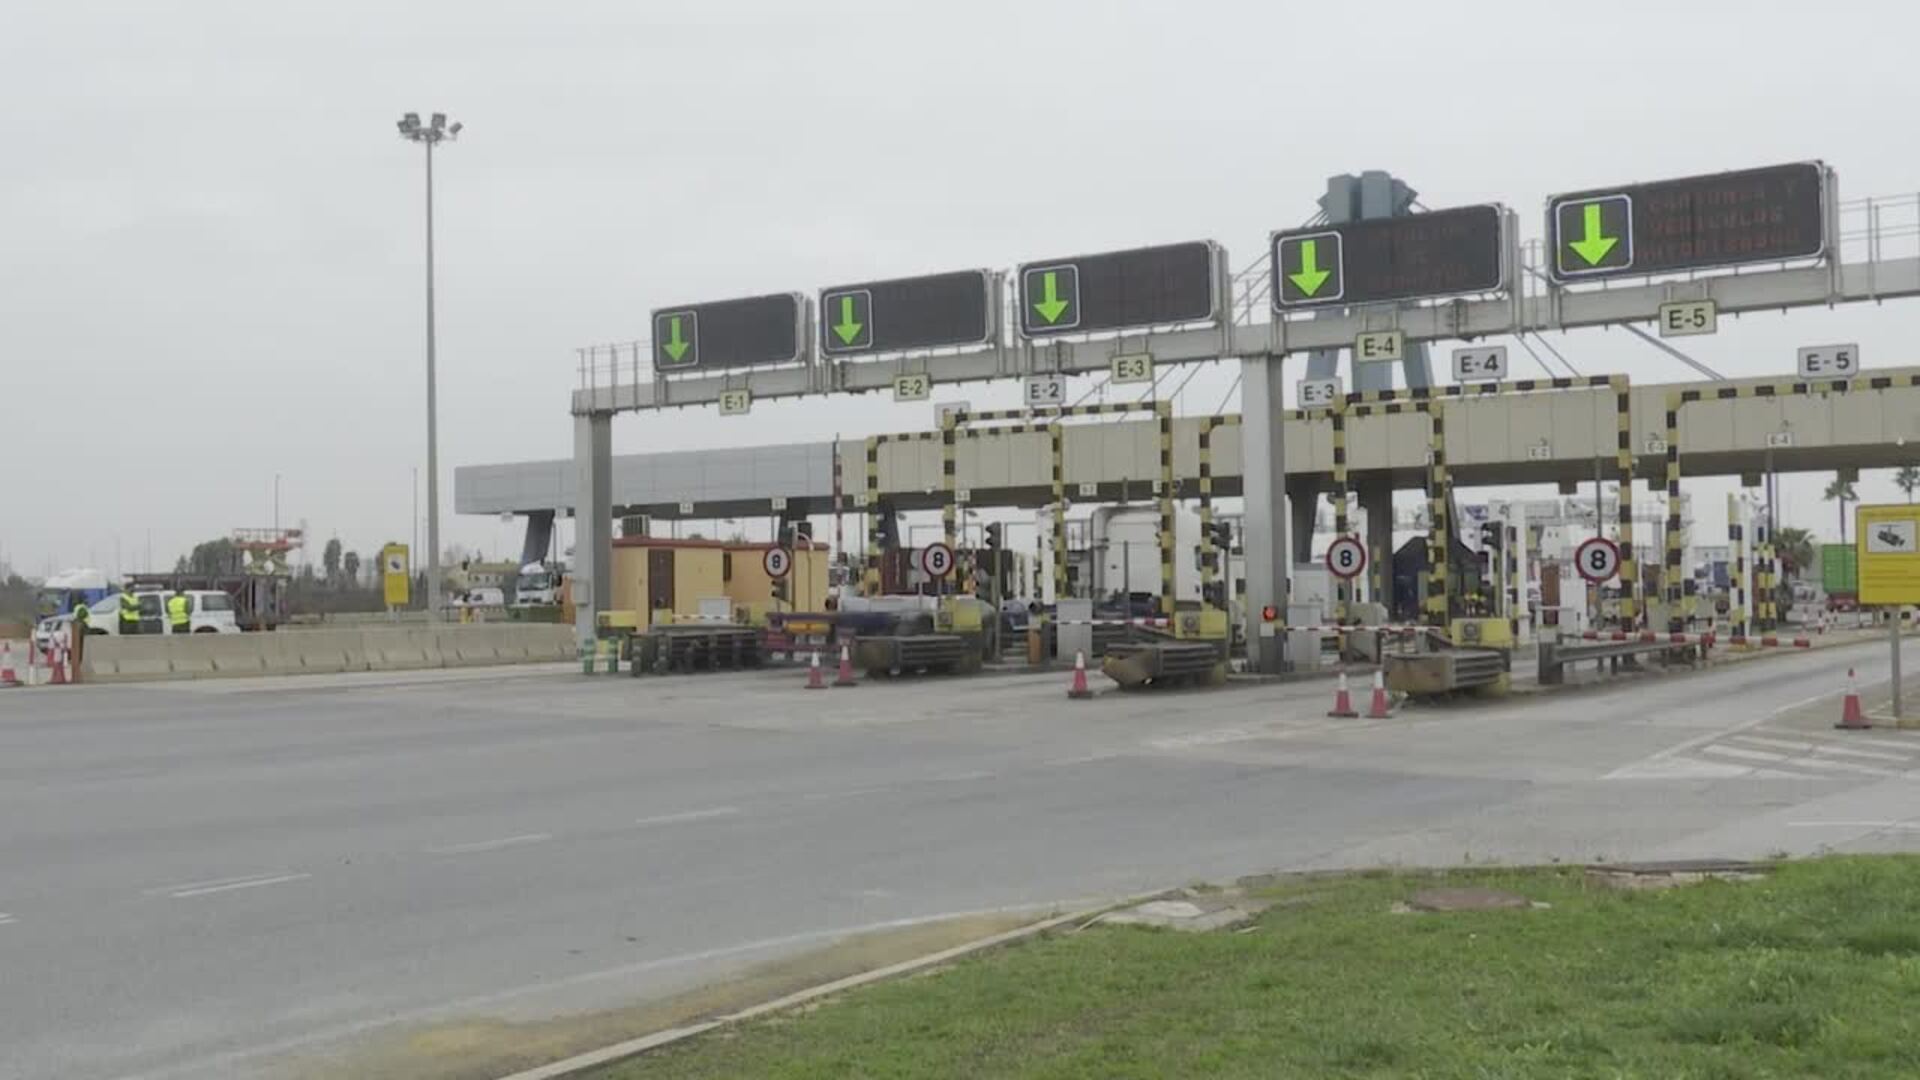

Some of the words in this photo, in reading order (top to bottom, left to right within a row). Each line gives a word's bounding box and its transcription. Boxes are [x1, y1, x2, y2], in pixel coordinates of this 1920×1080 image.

[1668, 307, 1707, 330] E-5
[1363, 337, 1395, 357] E-4
[1117, 359, 1145, 379] E-3
[1460, 354, 1500, 373] E-4
[1806, 351, 1850, 372] E-5
[899, 379, 922, 396] E-2
[1030, 382, 1060, 400] E-2
[1304, 384, 1335, 401] E-3
[725, 395, 744, 410] E-1
[772, 554, 782, 569] 8
[933, 551, 945, 569] 8
[1340, 549, 1353, 567] 8
[1590, 549, 1607, 571] 8
